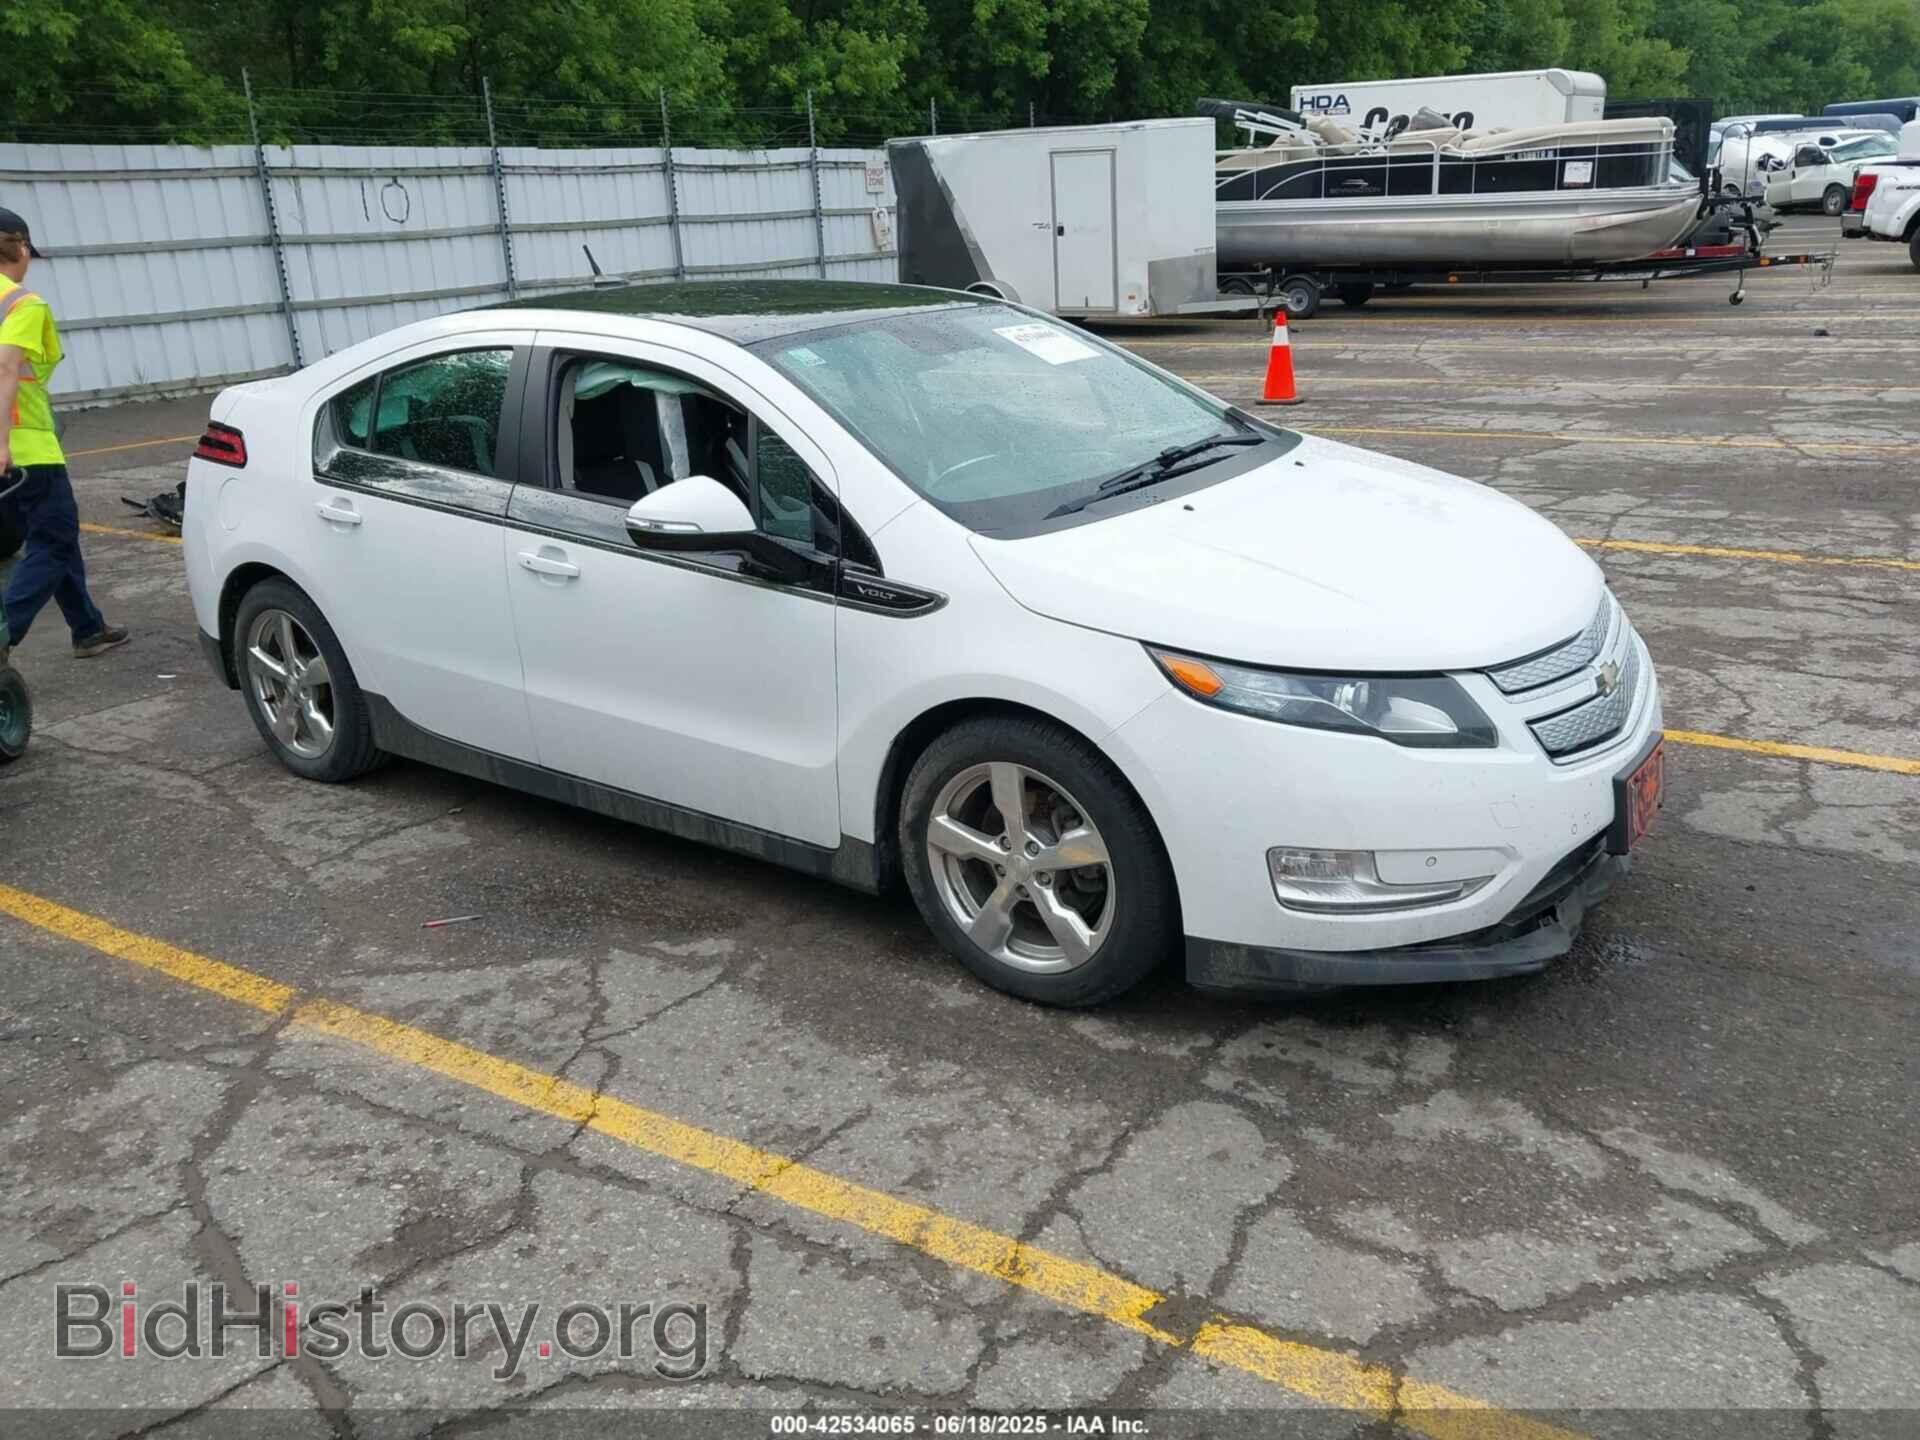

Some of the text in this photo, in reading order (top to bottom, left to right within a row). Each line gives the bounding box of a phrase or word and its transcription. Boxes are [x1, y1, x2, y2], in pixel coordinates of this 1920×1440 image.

[1300, 94, 1350, 109] HDA
[868, 176, 885, 186] ZONE
[360, 180, 410, 224] 10
[857, 585, 896, 600] VOLT
